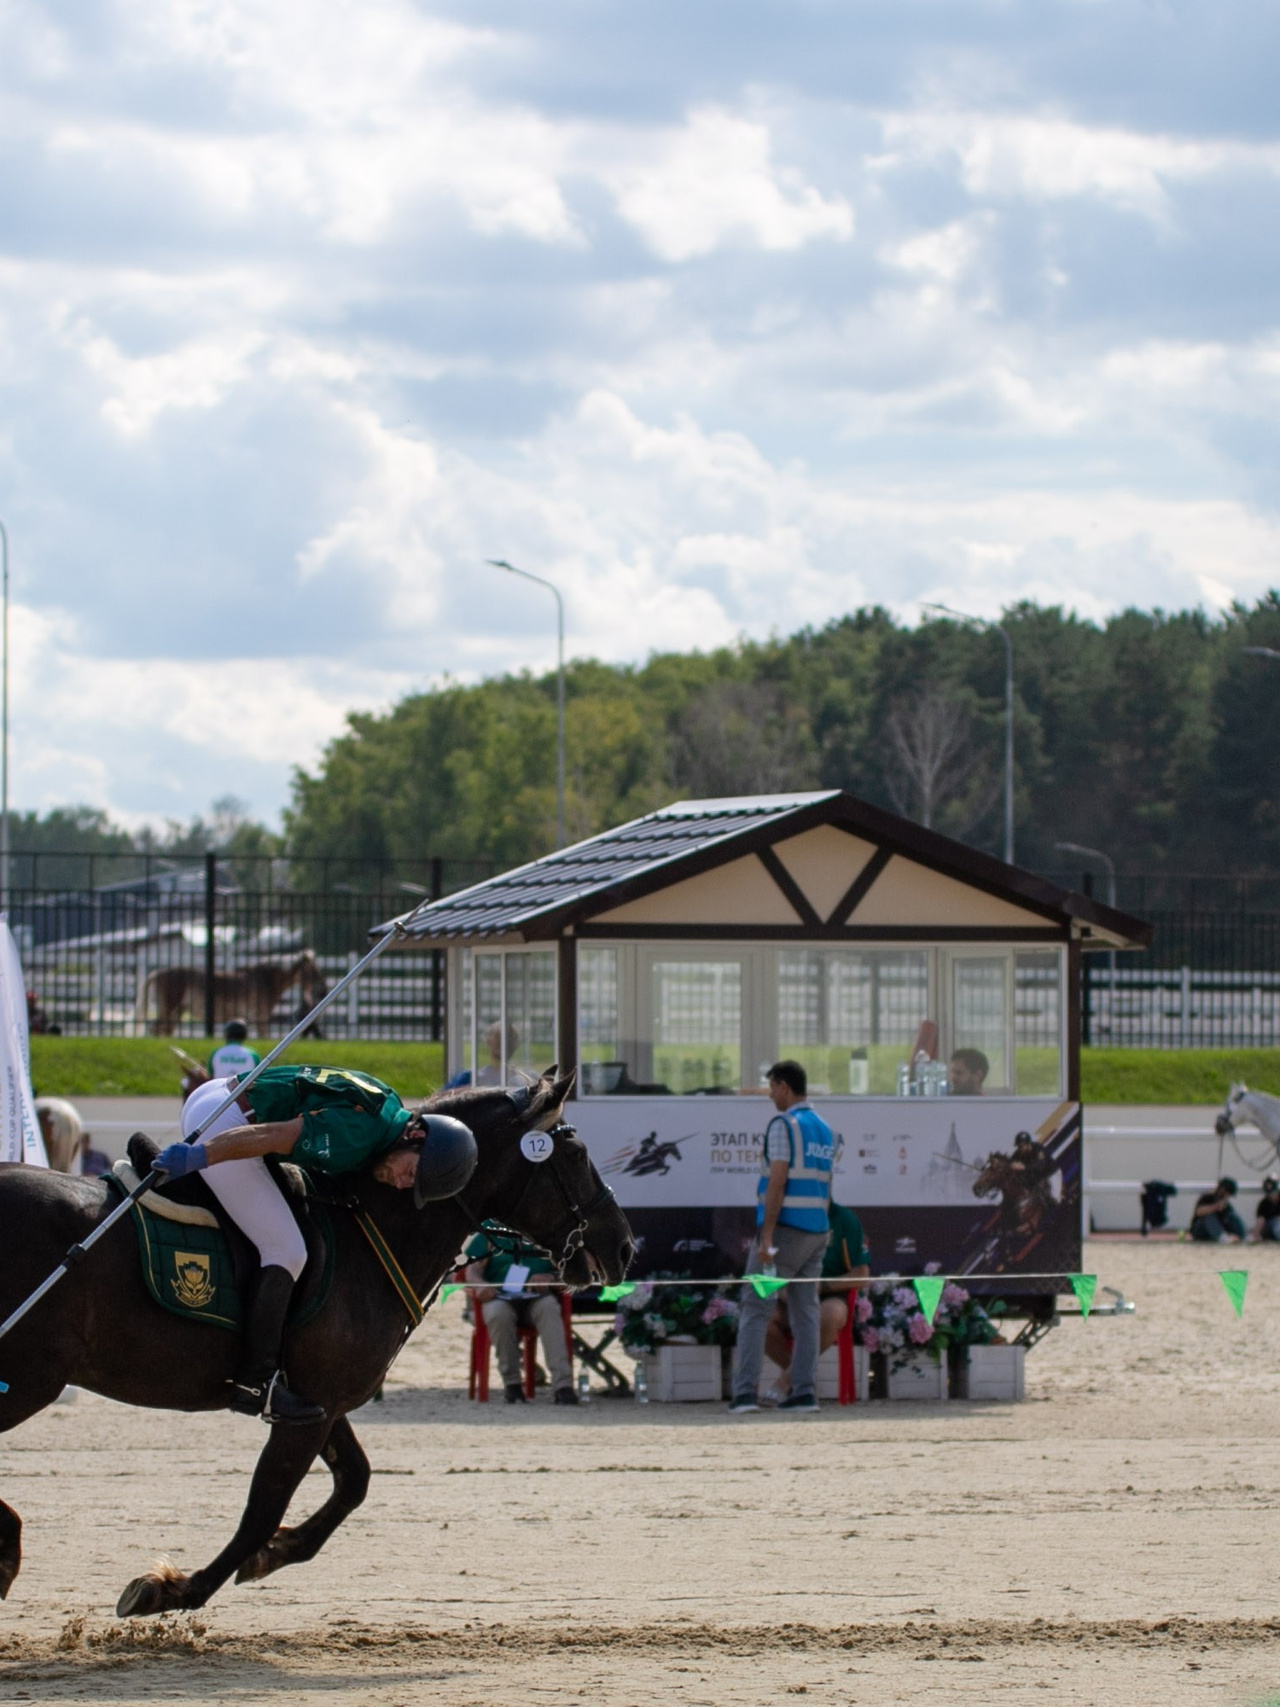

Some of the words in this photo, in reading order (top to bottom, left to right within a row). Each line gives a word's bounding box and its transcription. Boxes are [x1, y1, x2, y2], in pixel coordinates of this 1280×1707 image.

[6, 1065, 17, 1117] QUALIFIER
[9, 1119, 17, 1140] CUP
[529, 1139, 546, 1152] 12
[710, 1133, 747, 1146] ЭТАП
[711, 1151, 732, 1163] ПО
